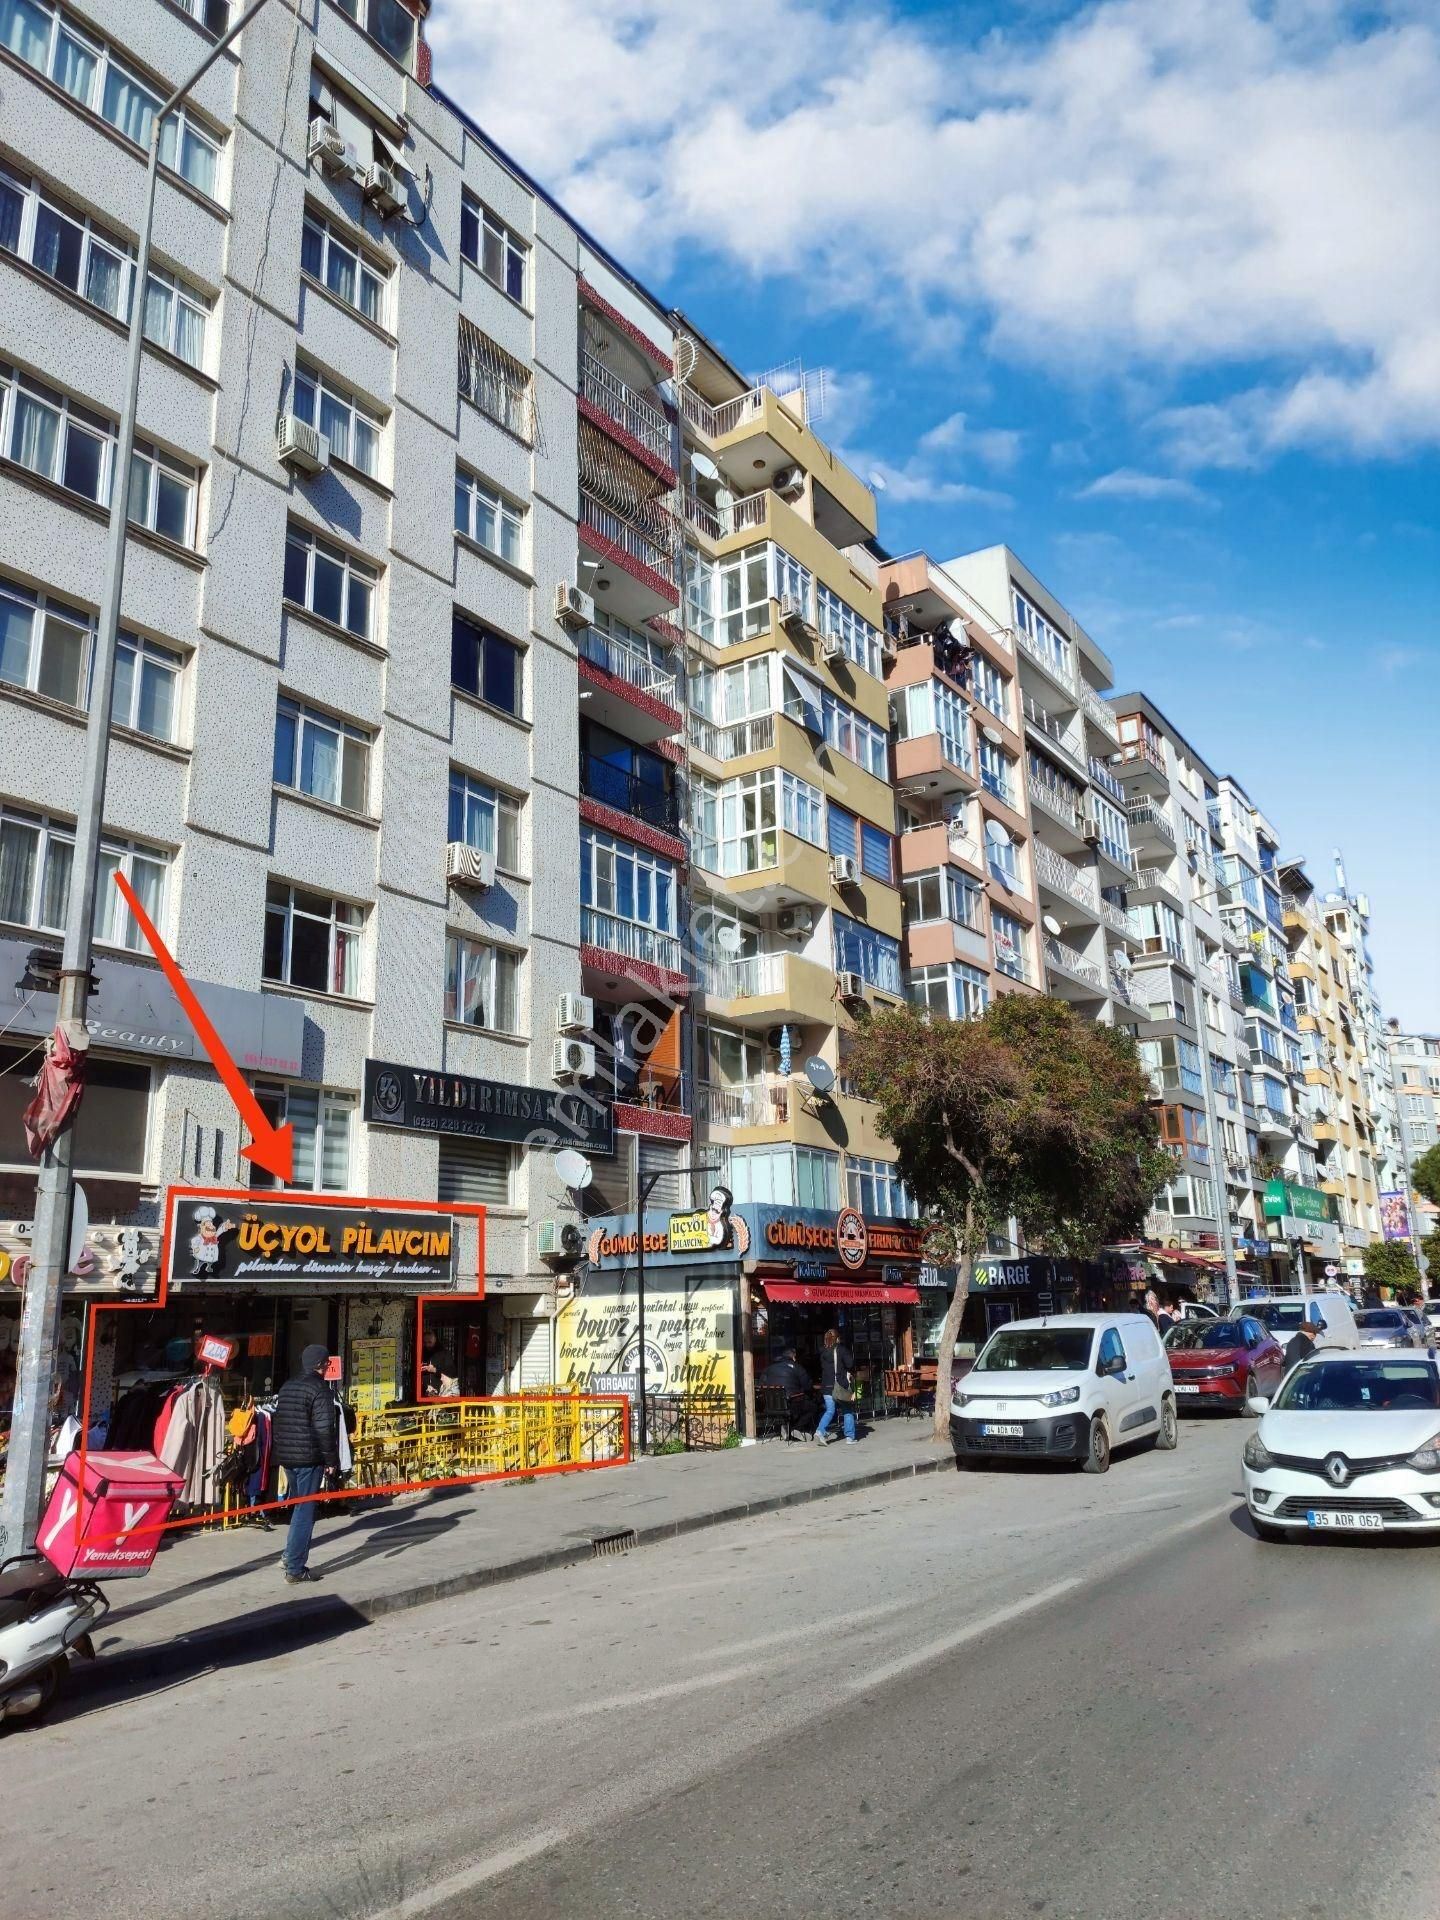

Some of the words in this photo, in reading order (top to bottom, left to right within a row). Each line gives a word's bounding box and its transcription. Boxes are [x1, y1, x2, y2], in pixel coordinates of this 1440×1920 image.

[86, 1020, 184, 1051] Beauty
[238, 1214, 331, 1258] ÜÇYOL
[342, 1221, 450, 1257] PİLAVCIM
[673, 1219, 707, 1236] ÜÇYOL
[768, 1220, 835, 1249] GÜMÜŞEGE
[988, 1265, 1030, 1287] BARGE
[577, 1308, 630, 1348] boyoz
[670, 1352, 727, 1384] simit
[594, 1377, 637, 1391] YORGANCI
[1316, 1513, 1328, 1525] 35
[1359, 1515, 1380, 1527] 062
[83, 1549, 153, 1562] Yemeksepeti
